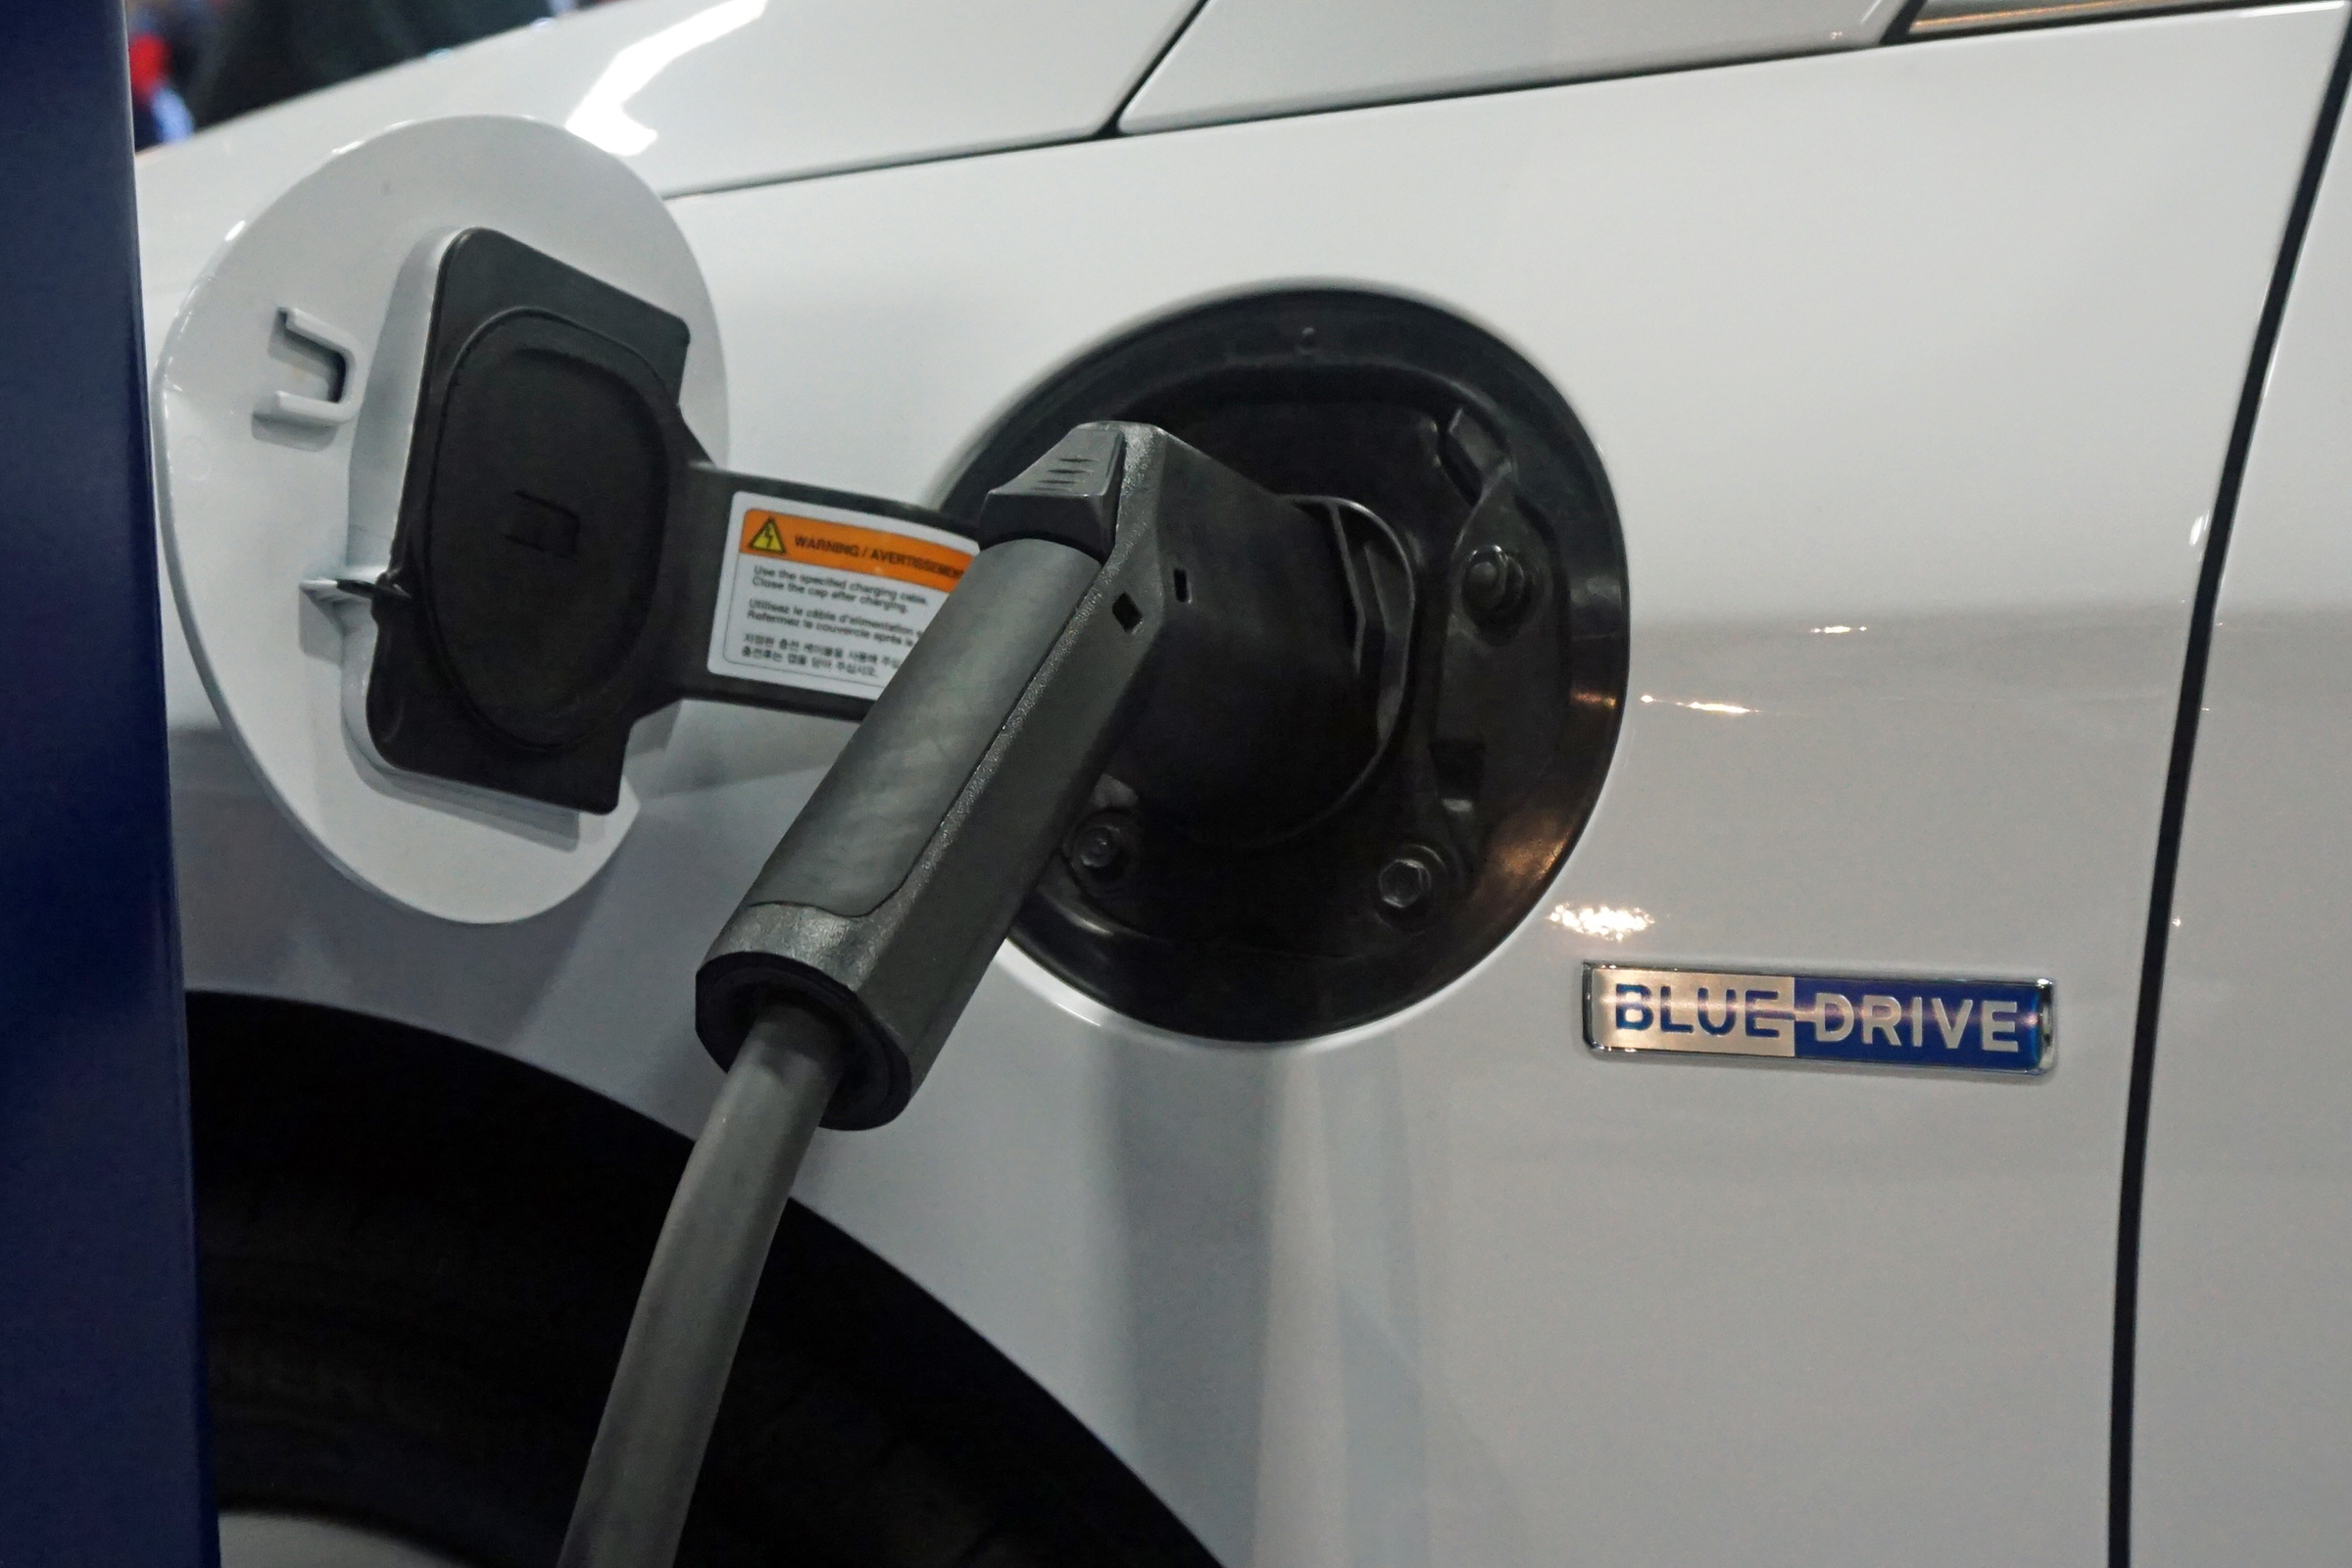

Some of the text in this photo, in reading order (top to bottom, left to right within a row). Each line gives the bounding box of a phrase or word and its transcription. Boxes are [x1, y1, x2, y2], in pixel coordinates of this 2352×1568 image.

[795, 535, 858, 558] WARNING
[752, 576, 784, 591] Close
[787, 581, 805, 594] the
[808, 586, 827, 601] cap
[830, 587, 856, 603] after
[754, 564, 774, 577] Use
[779, 567, 796, 580] the
[800, 571, 846, 590] specified
[849, 579, 897, 601] charging
[747, 609, 800, 627] Refermez
[804, 618, 813, 630] le
[749, 598, 789, 614] Utilisez
[793, 605, 803, 616] le
[1615, 982, 2019, 1054] BLUE DRIVE
